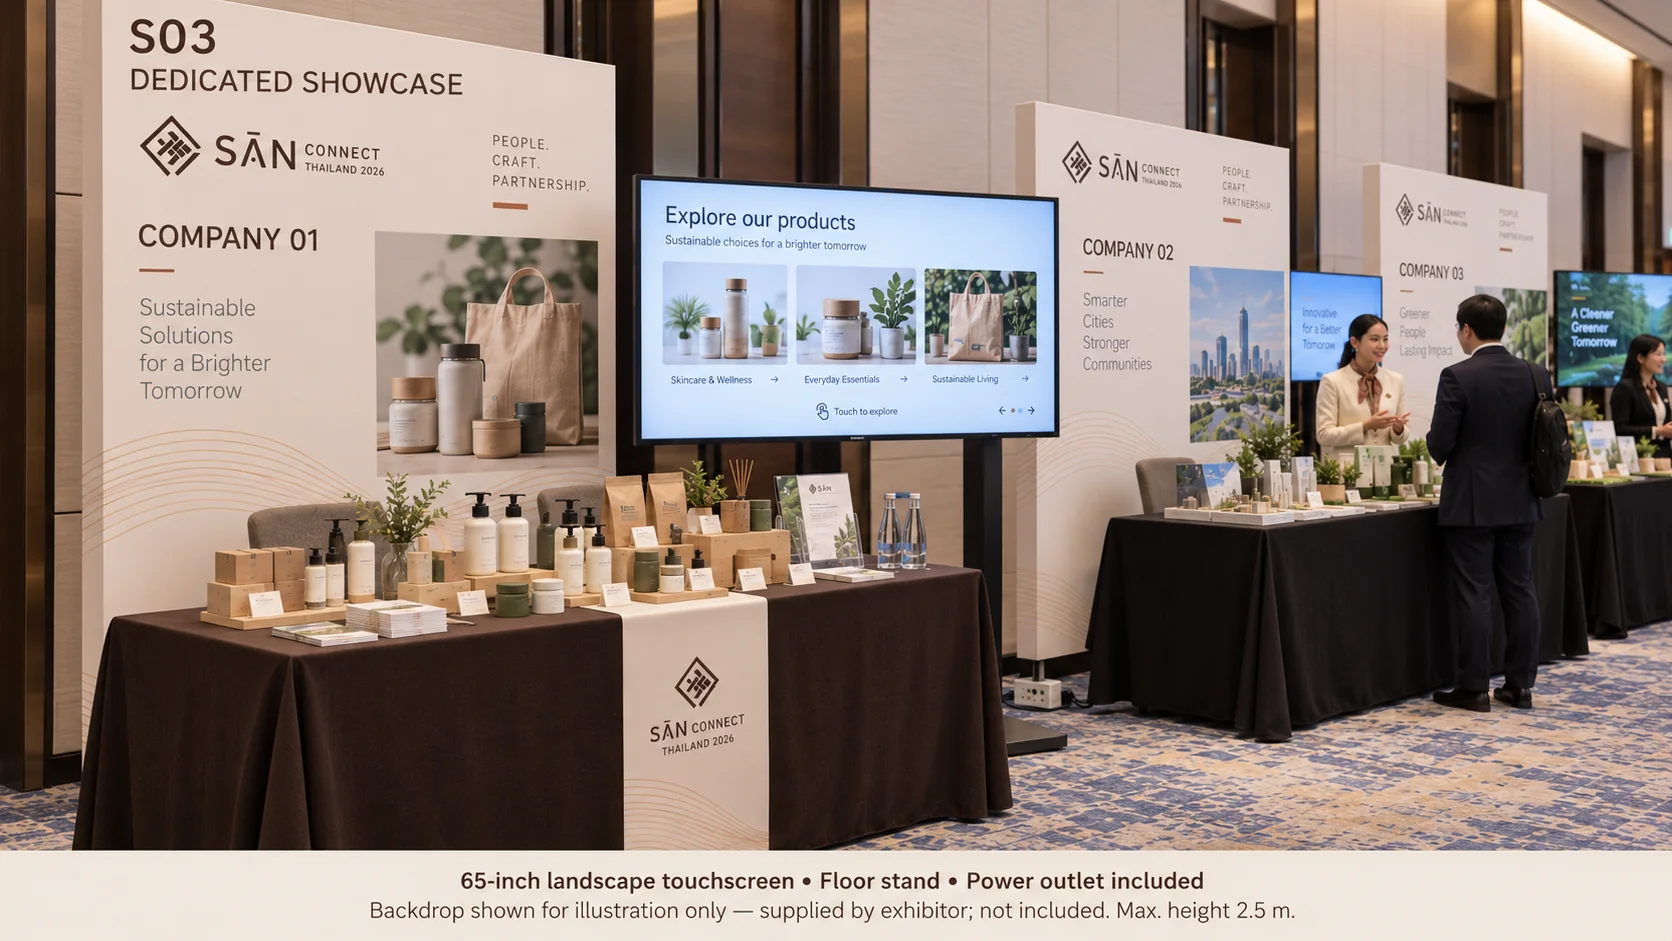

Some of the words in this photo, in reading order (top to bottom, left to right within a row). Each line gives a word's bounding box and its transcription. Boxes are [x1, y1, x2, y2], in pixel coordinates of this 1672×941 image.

[130, 19, 215, 54] S03
[132, 69, 292, 92] DEDICATED
[303, 71, 462, 95] SHOWCASE
[493, 135, 548, 150] PEOPLE.
[215, 132, 295, 170] SĀN
[305, 144, 380, 160] CONNECT
[305, 162, 357, 174] THAILAND
[361, 166, 384, 176] 2026
[493, 154, 539, 169] CRAFT.
[1099, 154, 1137, 182] SĀN
[1142, 163, 1180, 177] CONNECT
[1223, 166, 1251, 178] PEOPLE.
[493, 175, 589, 191] PARTNERSHIP.
[1223, 181, 1247, 193] CRAFT.
[1223, 197, 1272, 211] PARTNERSHIP.
[666, 206, 736, 227] Explore
[743, 214, 772, 227] our
[779, 212, 855, 232] products
[1418, 202, 1441, 223] SĀN
[139, 224, 280, 250] COMPANY
[291, 229, 317, 251] 01
[666, 235, 721, 246] Sustainable
[723, 237, 759, 247] choices
[762, 238, 775, 248] for
[786, 239, 821, 251] brighter
[824, 242, 866, 251] tomorrow
[1083, 238, 1154, 259] COMPANY
[1158, 244, 1173, 260] 02
[1400, 263, 1449, 279] COMPANY
[1453, 266, 1463, 280] 03
[140, 298, 255, 316] Sustainable
[1084, 292, 1127, 307] Smarter
[1302, 307, 1337, 318] Innovative
[1400, 307, 1430, 319] Greener
[1571, 307, 1578, 319] A
[1083, 314, 1114, 328] Cities
[1302, 323, 1312, 334] for
[1314, 326, 1319, 334] a
[1571, 321, 1609, 333] Greener
[140, 326, 233, 344] Solutions
[1400, 325, 1426, 339] People
[1084, 335, 1130, 353] Stronger
[1571, 335, 1618, 348] Tomorrow
[1400, 345, 1427, 359] Lasting
[1428, 345, 1452, 359] Impact
[140, 353, 167, 371] for
[174, 359, 184, 371] a
[192, 354, 271, 376] Brighter
[1083, 357, 1152, 371] Communities
[670, 375, 707, 385] Skincare
[708, 375, 715, 384] &
[716, 375, 753, 385] Wellness
[805, 375, 840, 385] Everyday
[842, 375, 879, 383] Essentials
[933, 375, 975, 383] Sustainable
[977, 375, 998, 385] Living
[140, 382, 242, 399] Tomorrow
[834, 407, 857, 416] Touch
[859, 408, 868, 416] to
[869, 407, 898, 417] explore
[650, 720, 687, 743] SĀN
[692, 714, 744, 733] CONNECT
[661, 738, 710, 756] THAILAND
[713, 734, 734, 746] 2026
